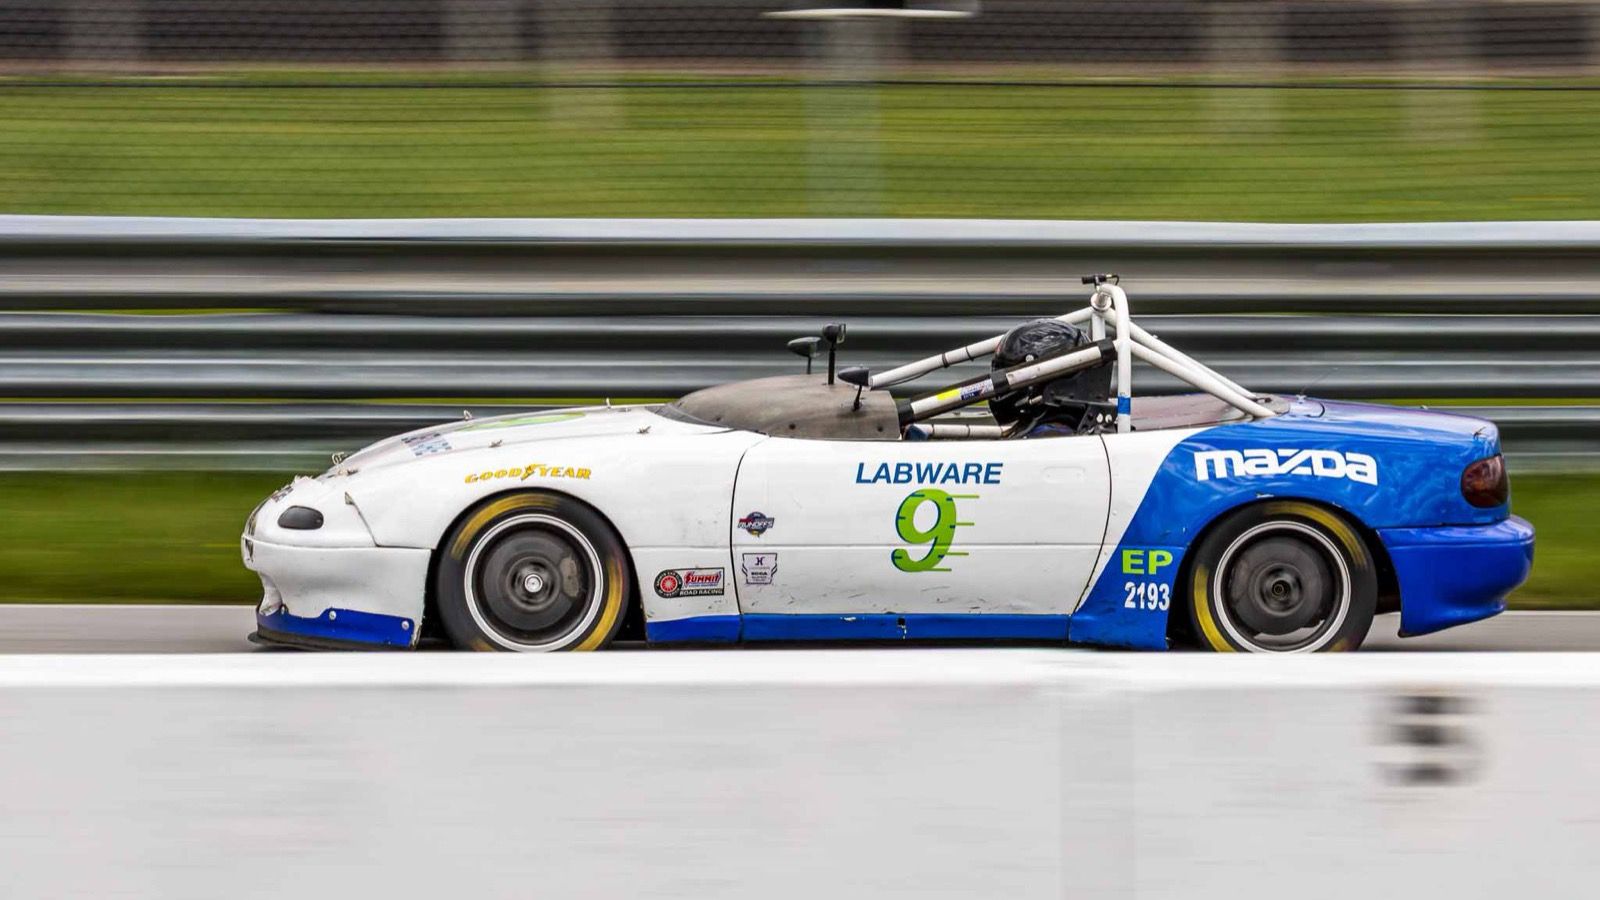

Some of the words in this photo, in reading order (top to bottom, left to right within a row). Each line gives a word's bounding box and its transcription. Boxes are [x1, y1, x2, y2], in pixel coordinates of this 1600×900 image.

[464, 463, 592, 484] GOODYEAR
[855, 462, 1004, 485] LABWARE
[891, 488, 957, 573] 9
[1122, 549, 1173, 575] EP
[680, 589, 698, 597] ROAD
[1124, 581, 1171, 611] 2193
